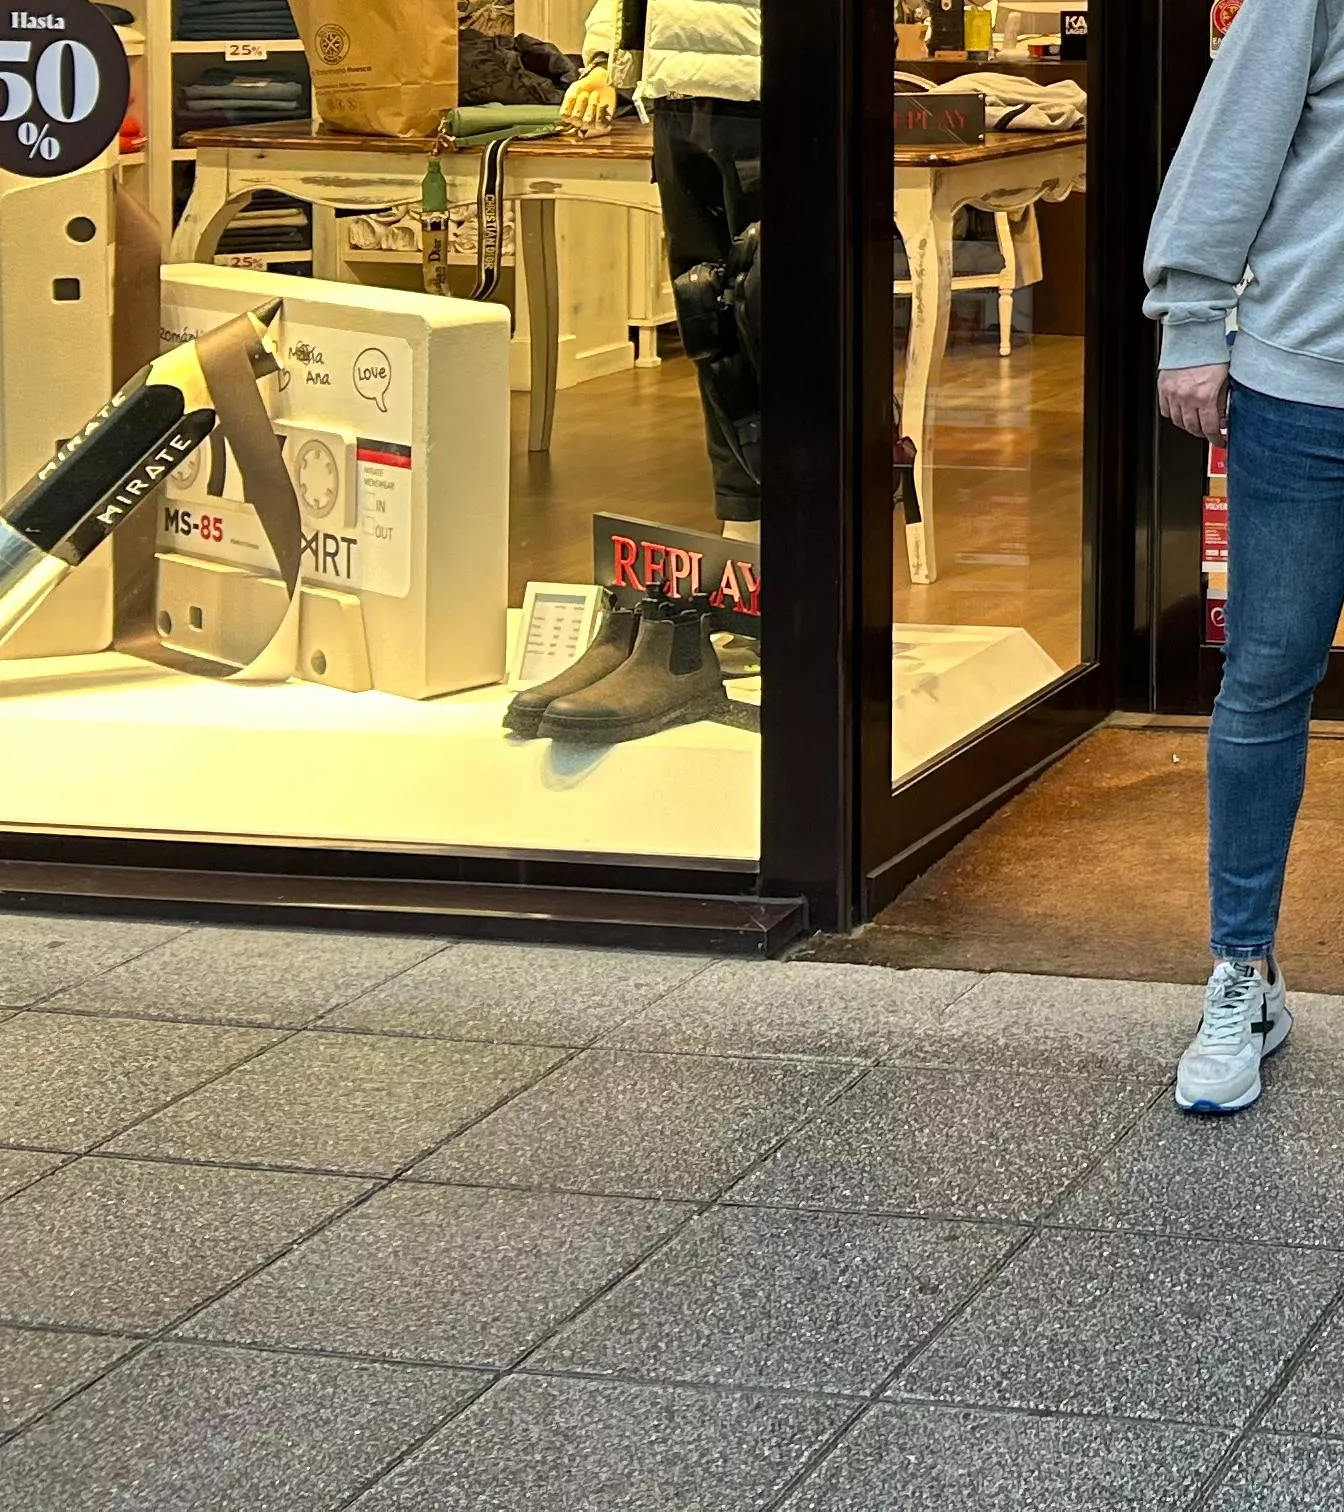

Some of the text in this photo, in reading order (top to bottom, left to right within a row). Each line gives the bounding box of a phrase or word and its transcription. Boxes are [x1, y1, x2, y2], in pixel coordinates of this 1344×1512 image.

[11, 11, 65, 30] Hasta
[229, 44, 263, 58] 25%
[17, 121, 61, 160] %
[97, 434, 192, 524] MIRATE
[376, 500, 385, 513] IN
[164, 507, 224, 543] MS-85
[375, 525, 393, 541] OUT
[610, 535, 761, 617] REPLAY
